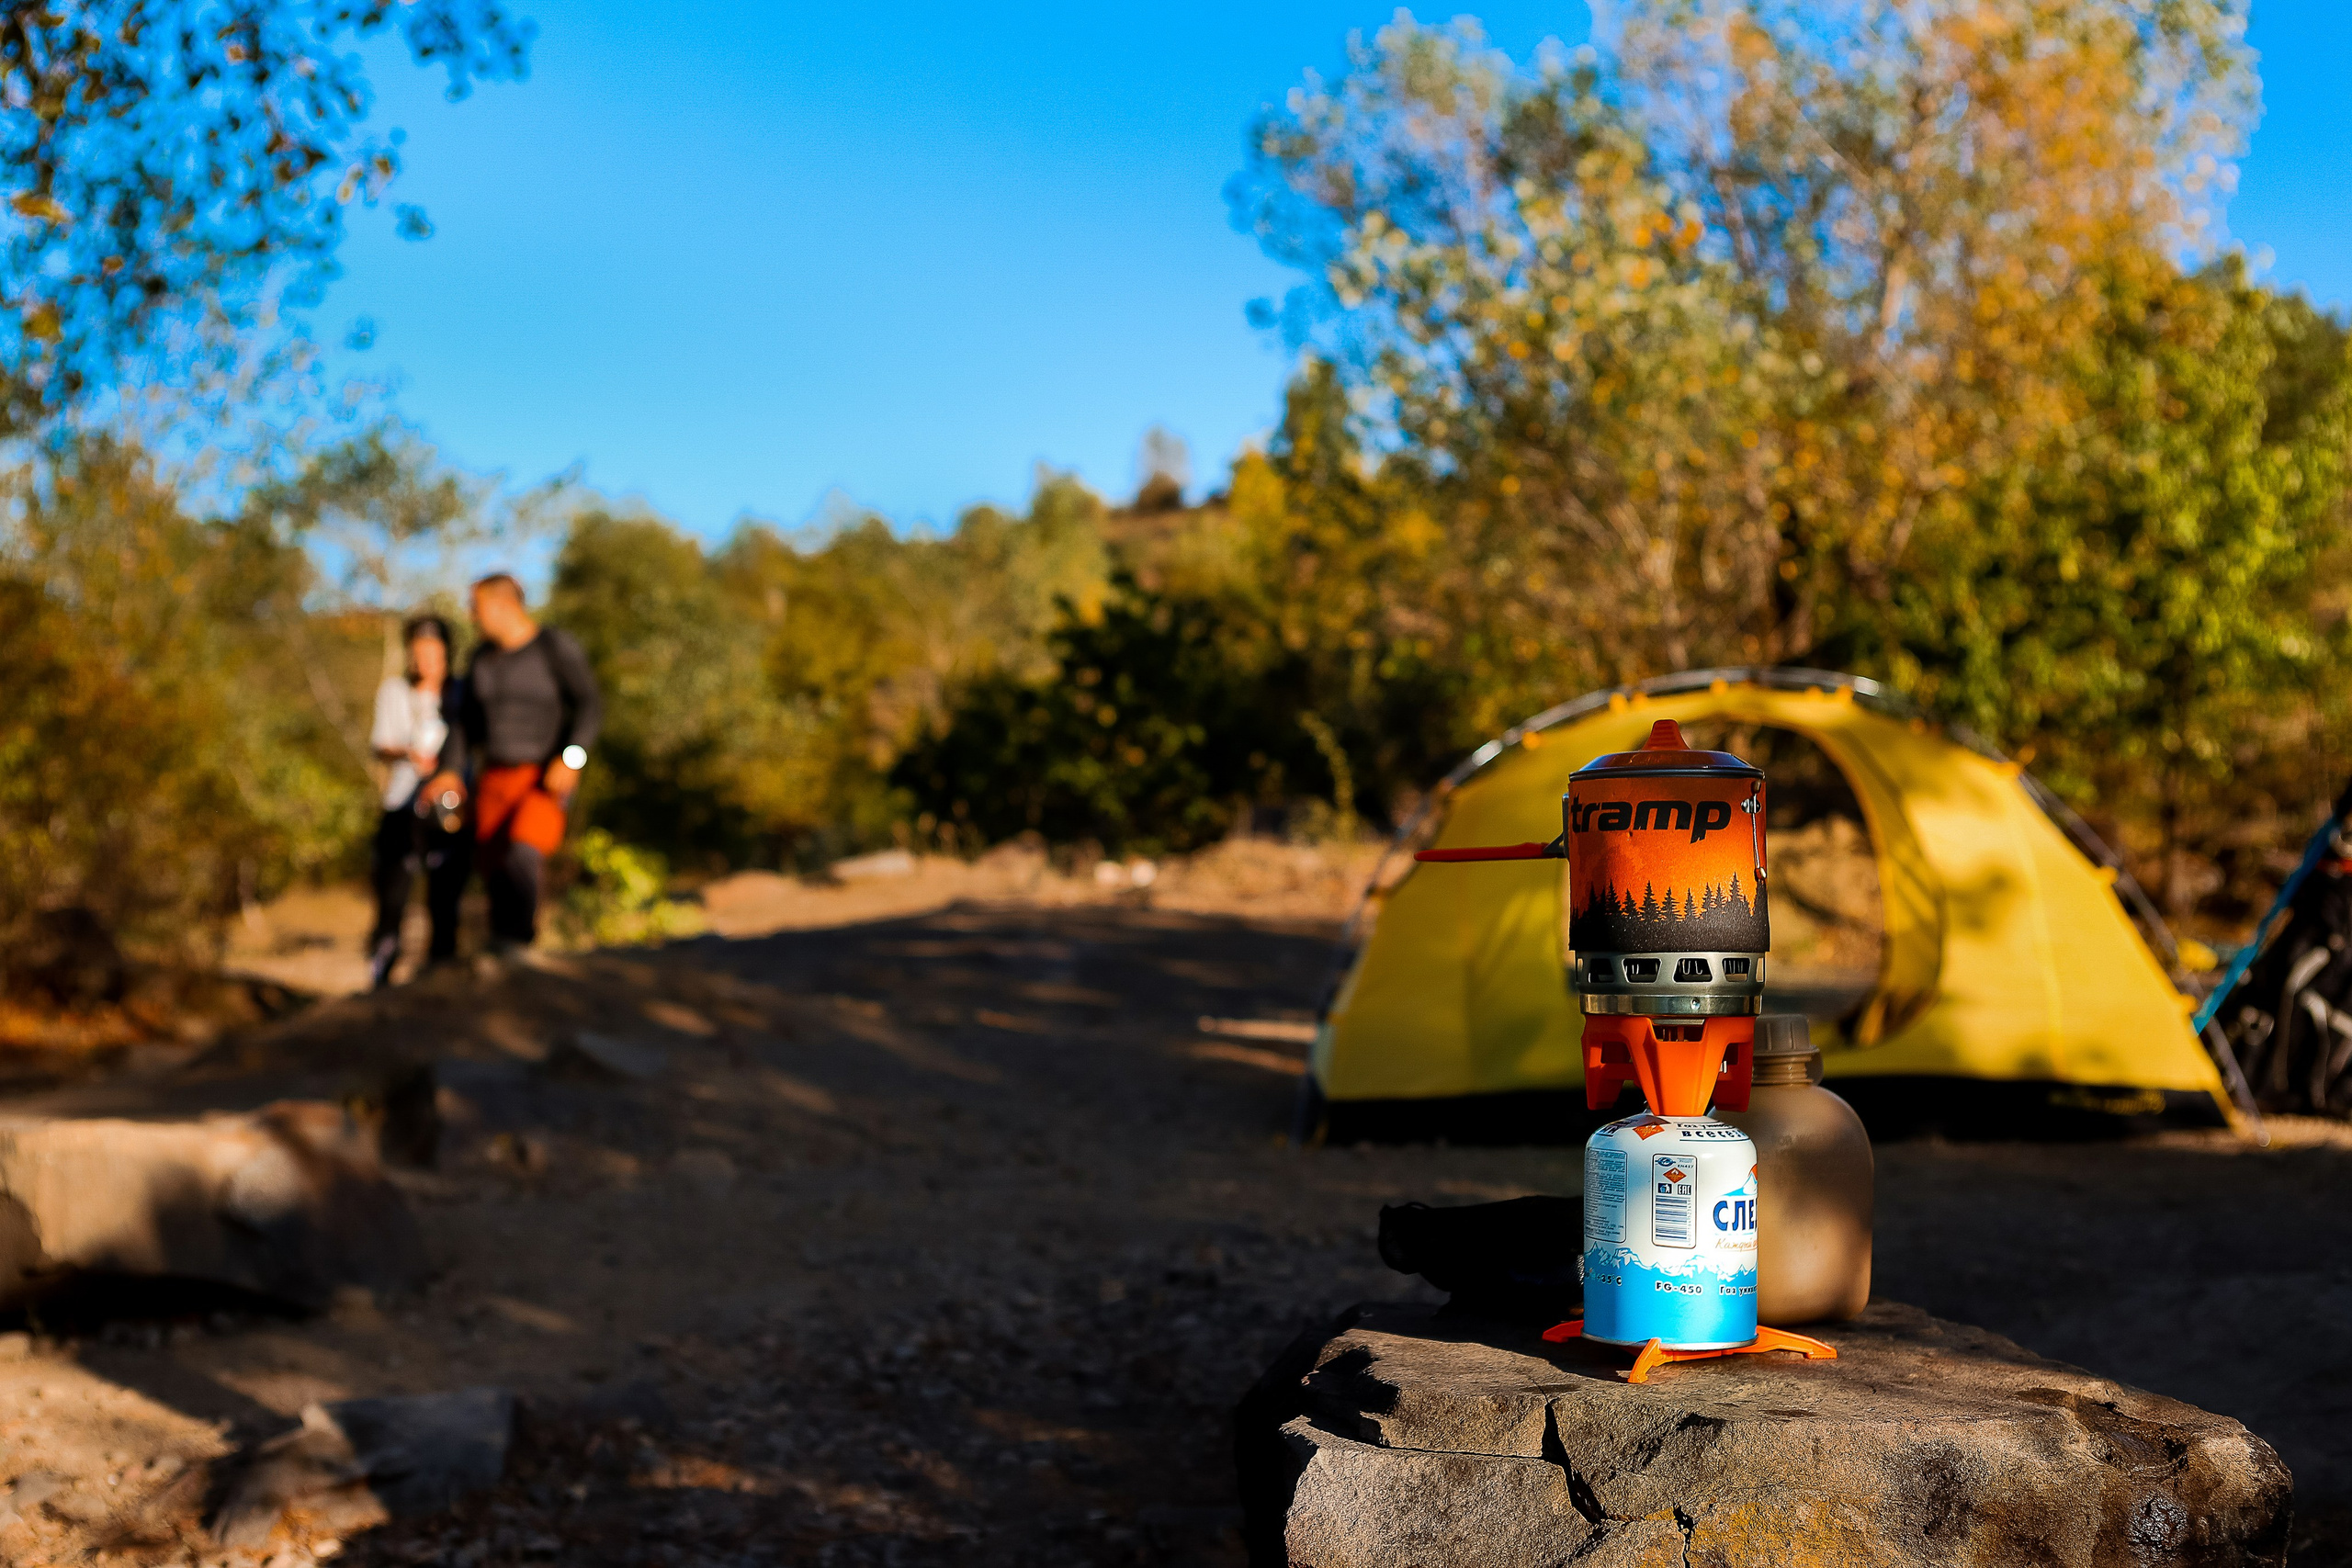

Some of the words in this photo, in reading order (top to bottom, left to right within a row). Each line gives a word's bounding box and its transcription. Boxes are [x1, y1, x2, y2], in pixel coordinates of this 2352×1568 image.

[1570, 792, 1732, 844] tramp
[1713, 1199, 1758, 1232] СЛЕ
[1656, 1281, 1702, 1294] FG-450
[1720, 1285, 1737, 1294] Газ
